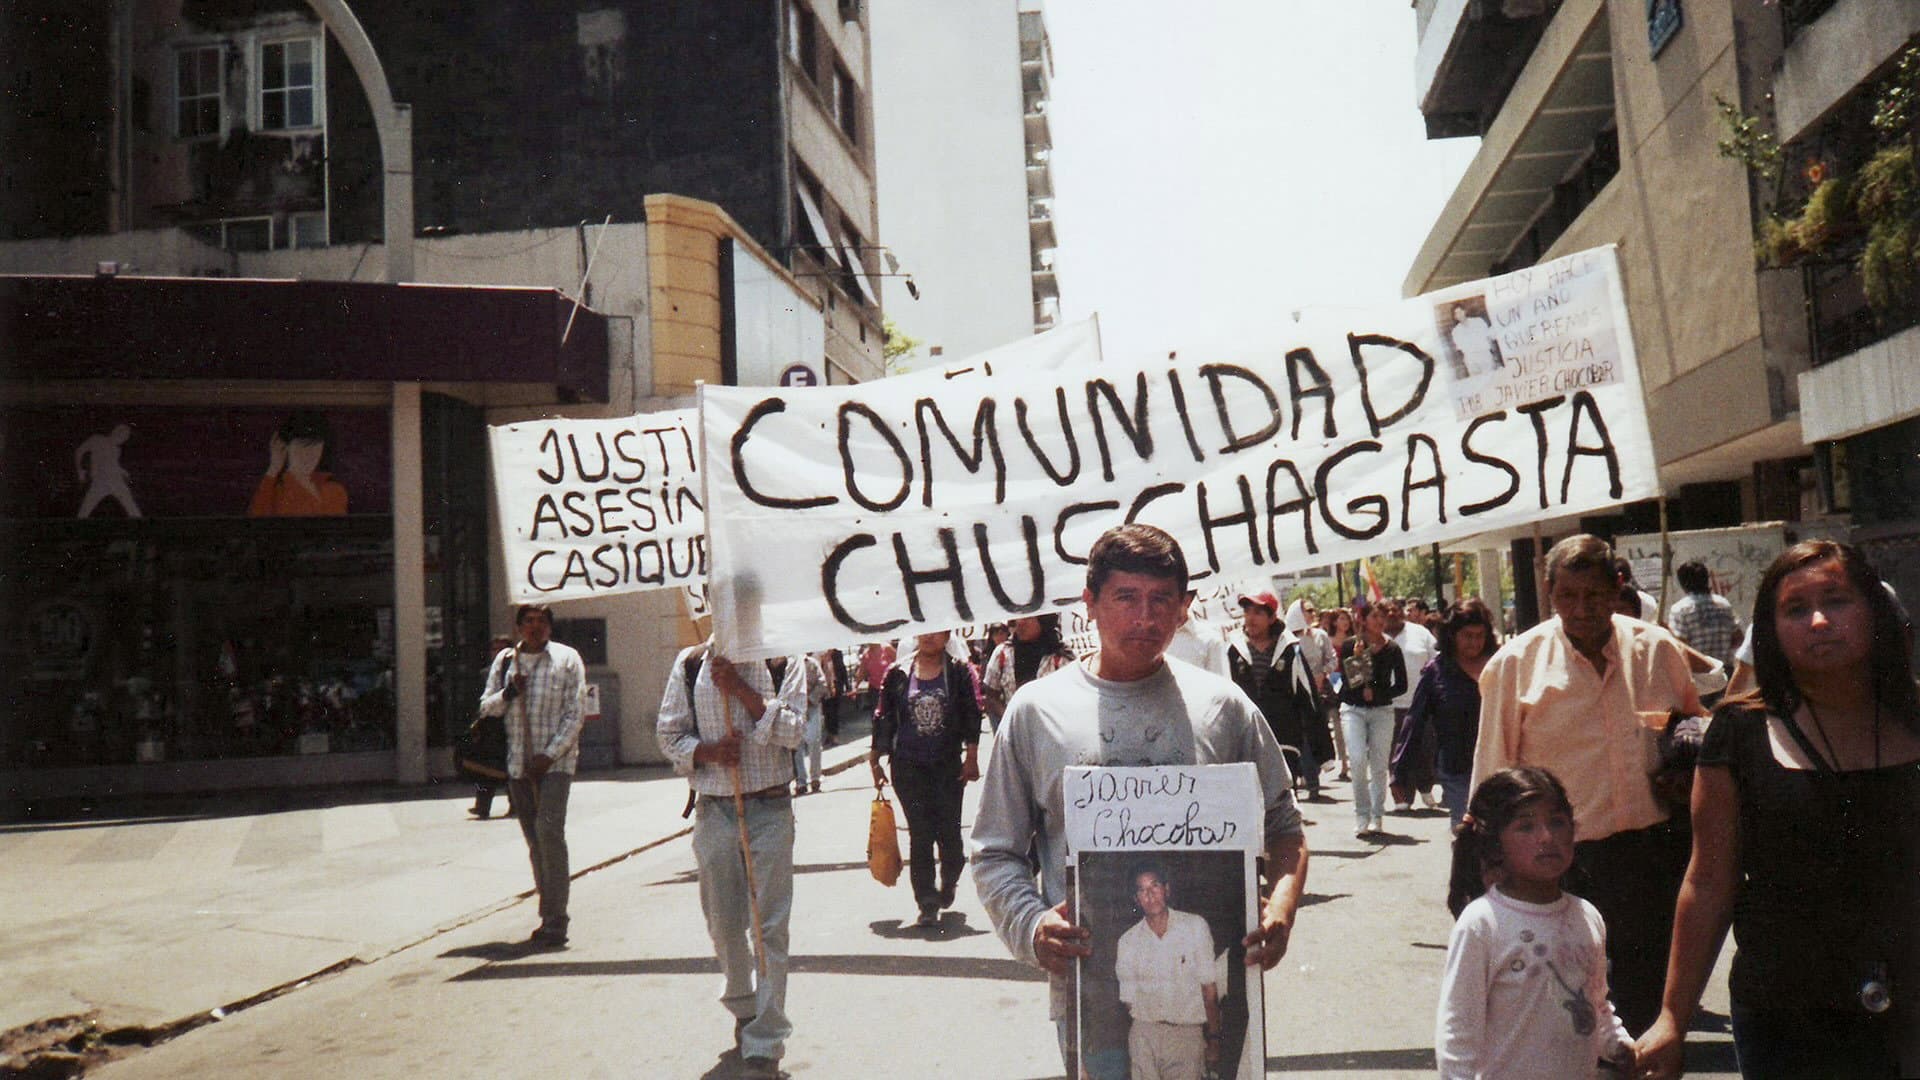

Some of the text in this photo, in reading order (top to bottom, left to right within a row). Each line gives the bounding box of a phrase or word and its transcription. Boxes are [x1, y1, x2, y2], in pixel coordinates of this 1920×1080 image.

[1496, 304, 1521, 328] UN
[1506, 337, 1594, 378] JUSTICIA
[1495, 375, 1549, 406] JAVIER
[732, 332, 1435, 512] COMUNIDAD
